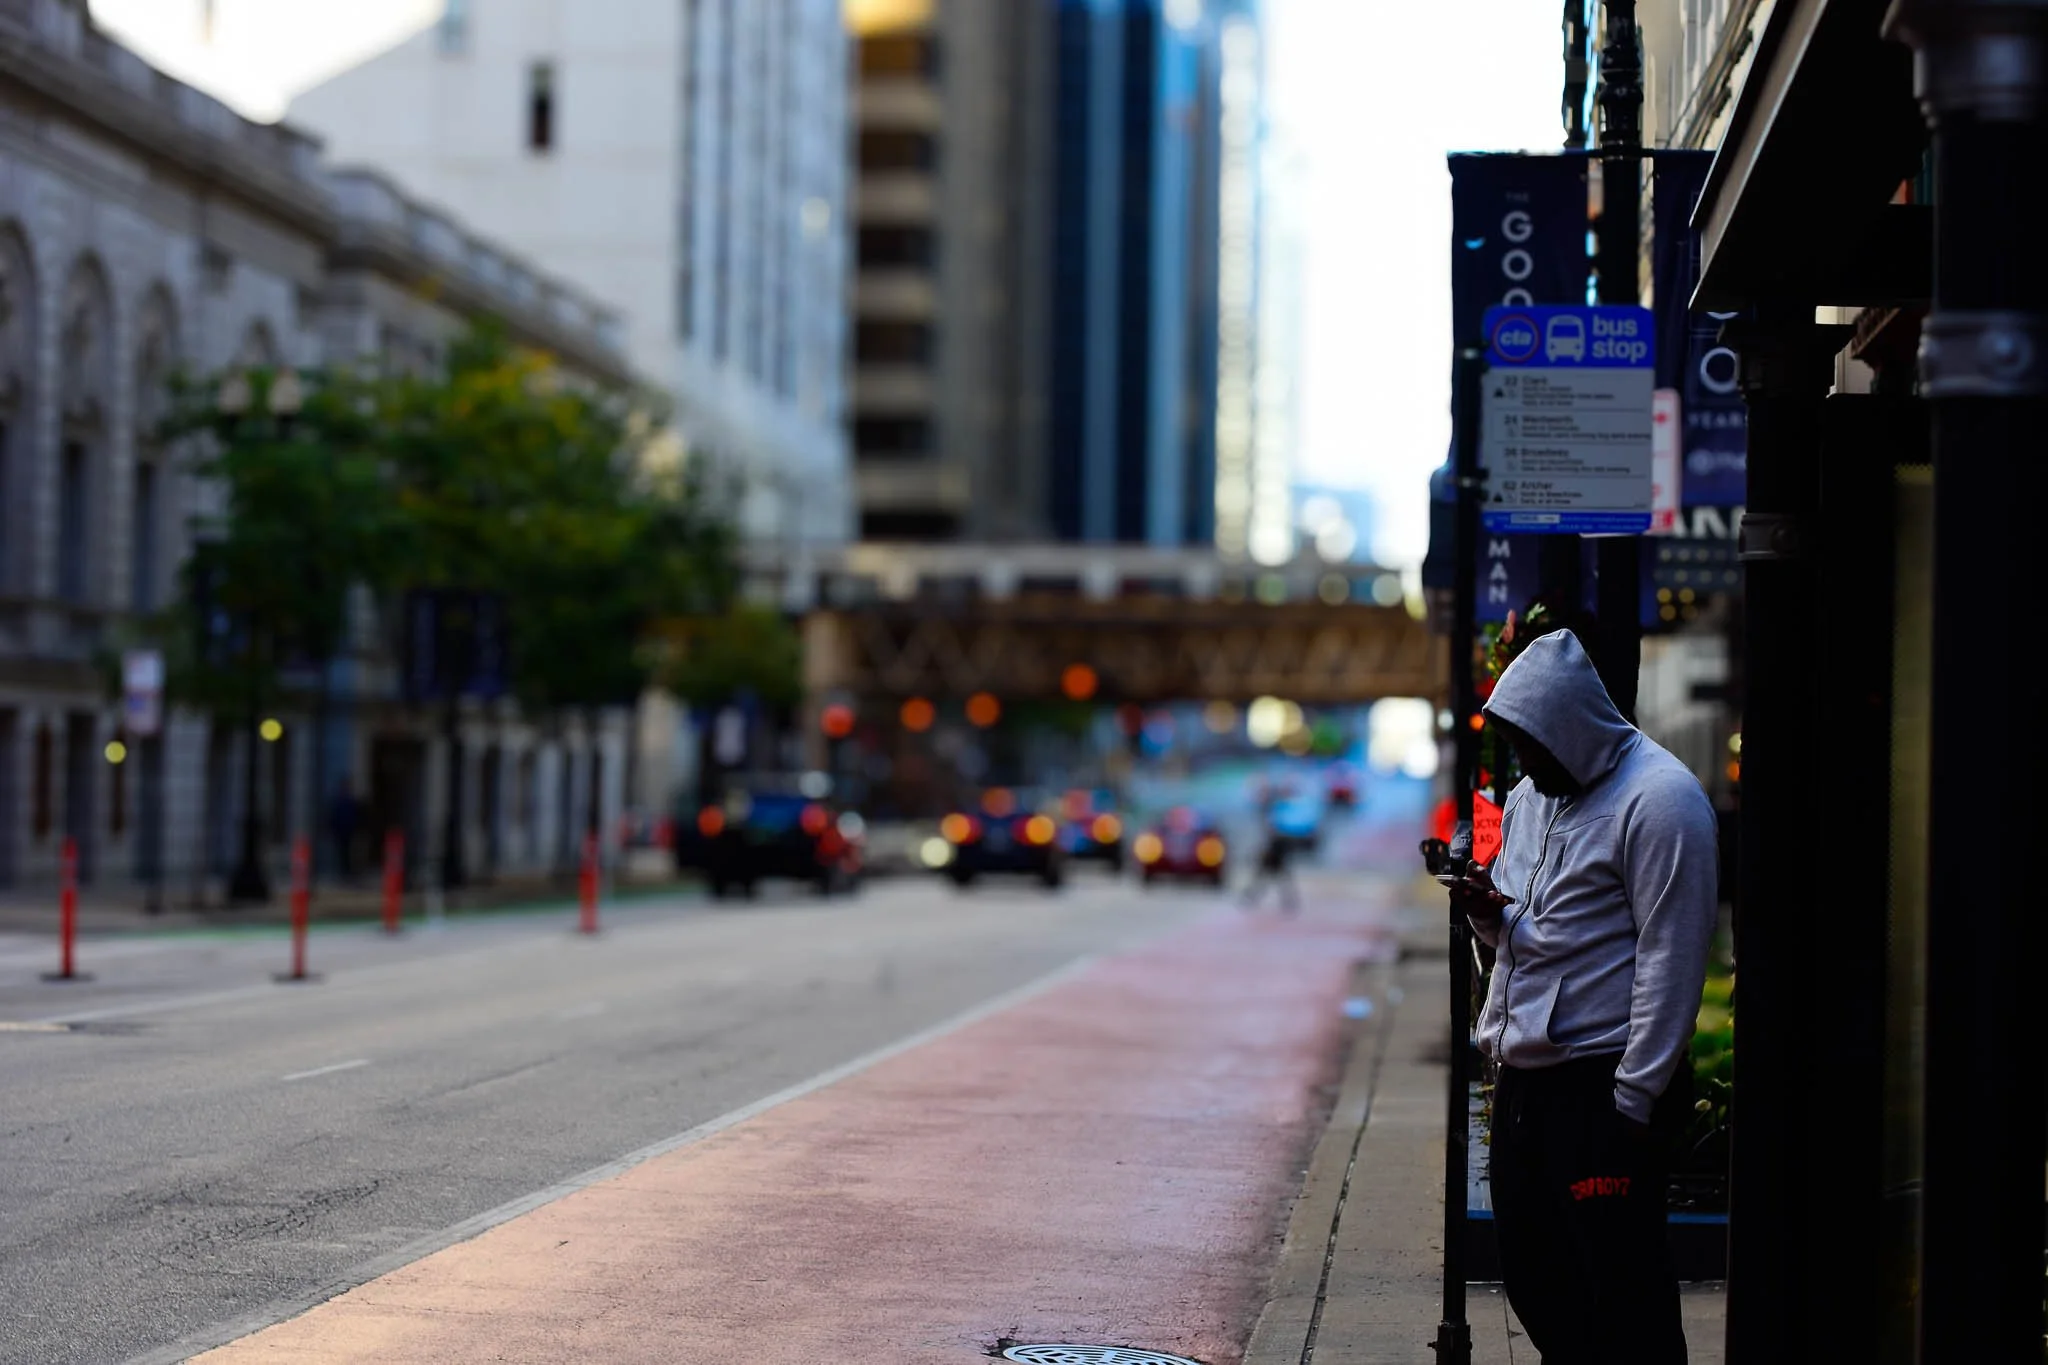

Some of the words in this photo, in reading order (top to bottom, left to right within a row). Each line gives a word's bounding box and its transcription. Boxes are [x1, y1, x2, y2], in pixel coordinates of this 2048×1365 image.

[1501, 329, 1532, 346] cta
[1592, 314, 1638, 337] bus
[1592, 337, 1648, 364] stop
[1488, 539, 1510, 604] MAN
